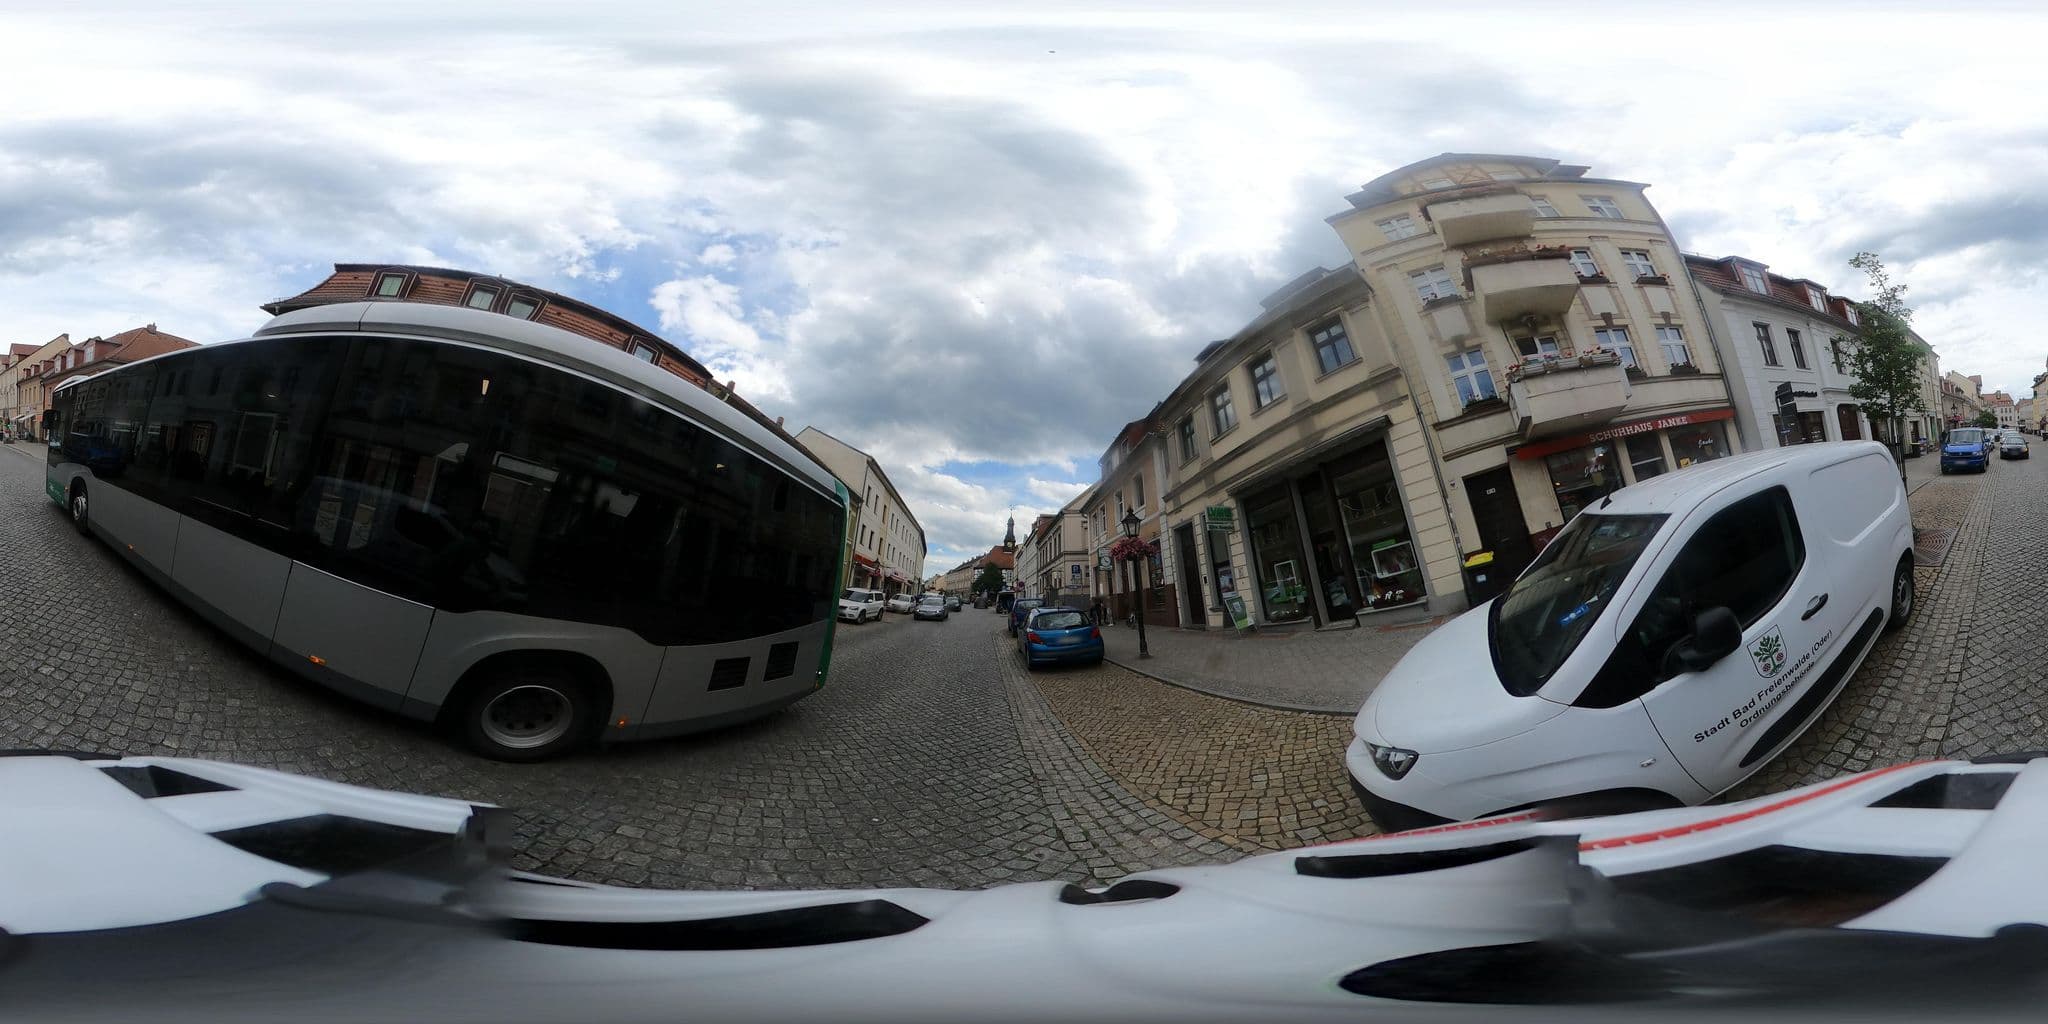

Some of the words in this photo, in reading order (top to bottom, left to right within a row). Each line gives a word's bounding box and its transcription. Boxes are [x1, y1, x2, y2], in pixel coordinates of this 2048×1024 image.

[1589, 421, 1654, 443] SCHUHHAUS
[1657, 416, 1689, 430] JANKE
[1694, 717, 1731, 743] Stadt
[1732, 698, 1756, 720] Bad
[1757, 652, 1811, 701] Freienwalde
[1811, 630, 1833, 655] (Oder)
[1739, 661, 1815, 728] Ordnungsbehörde
